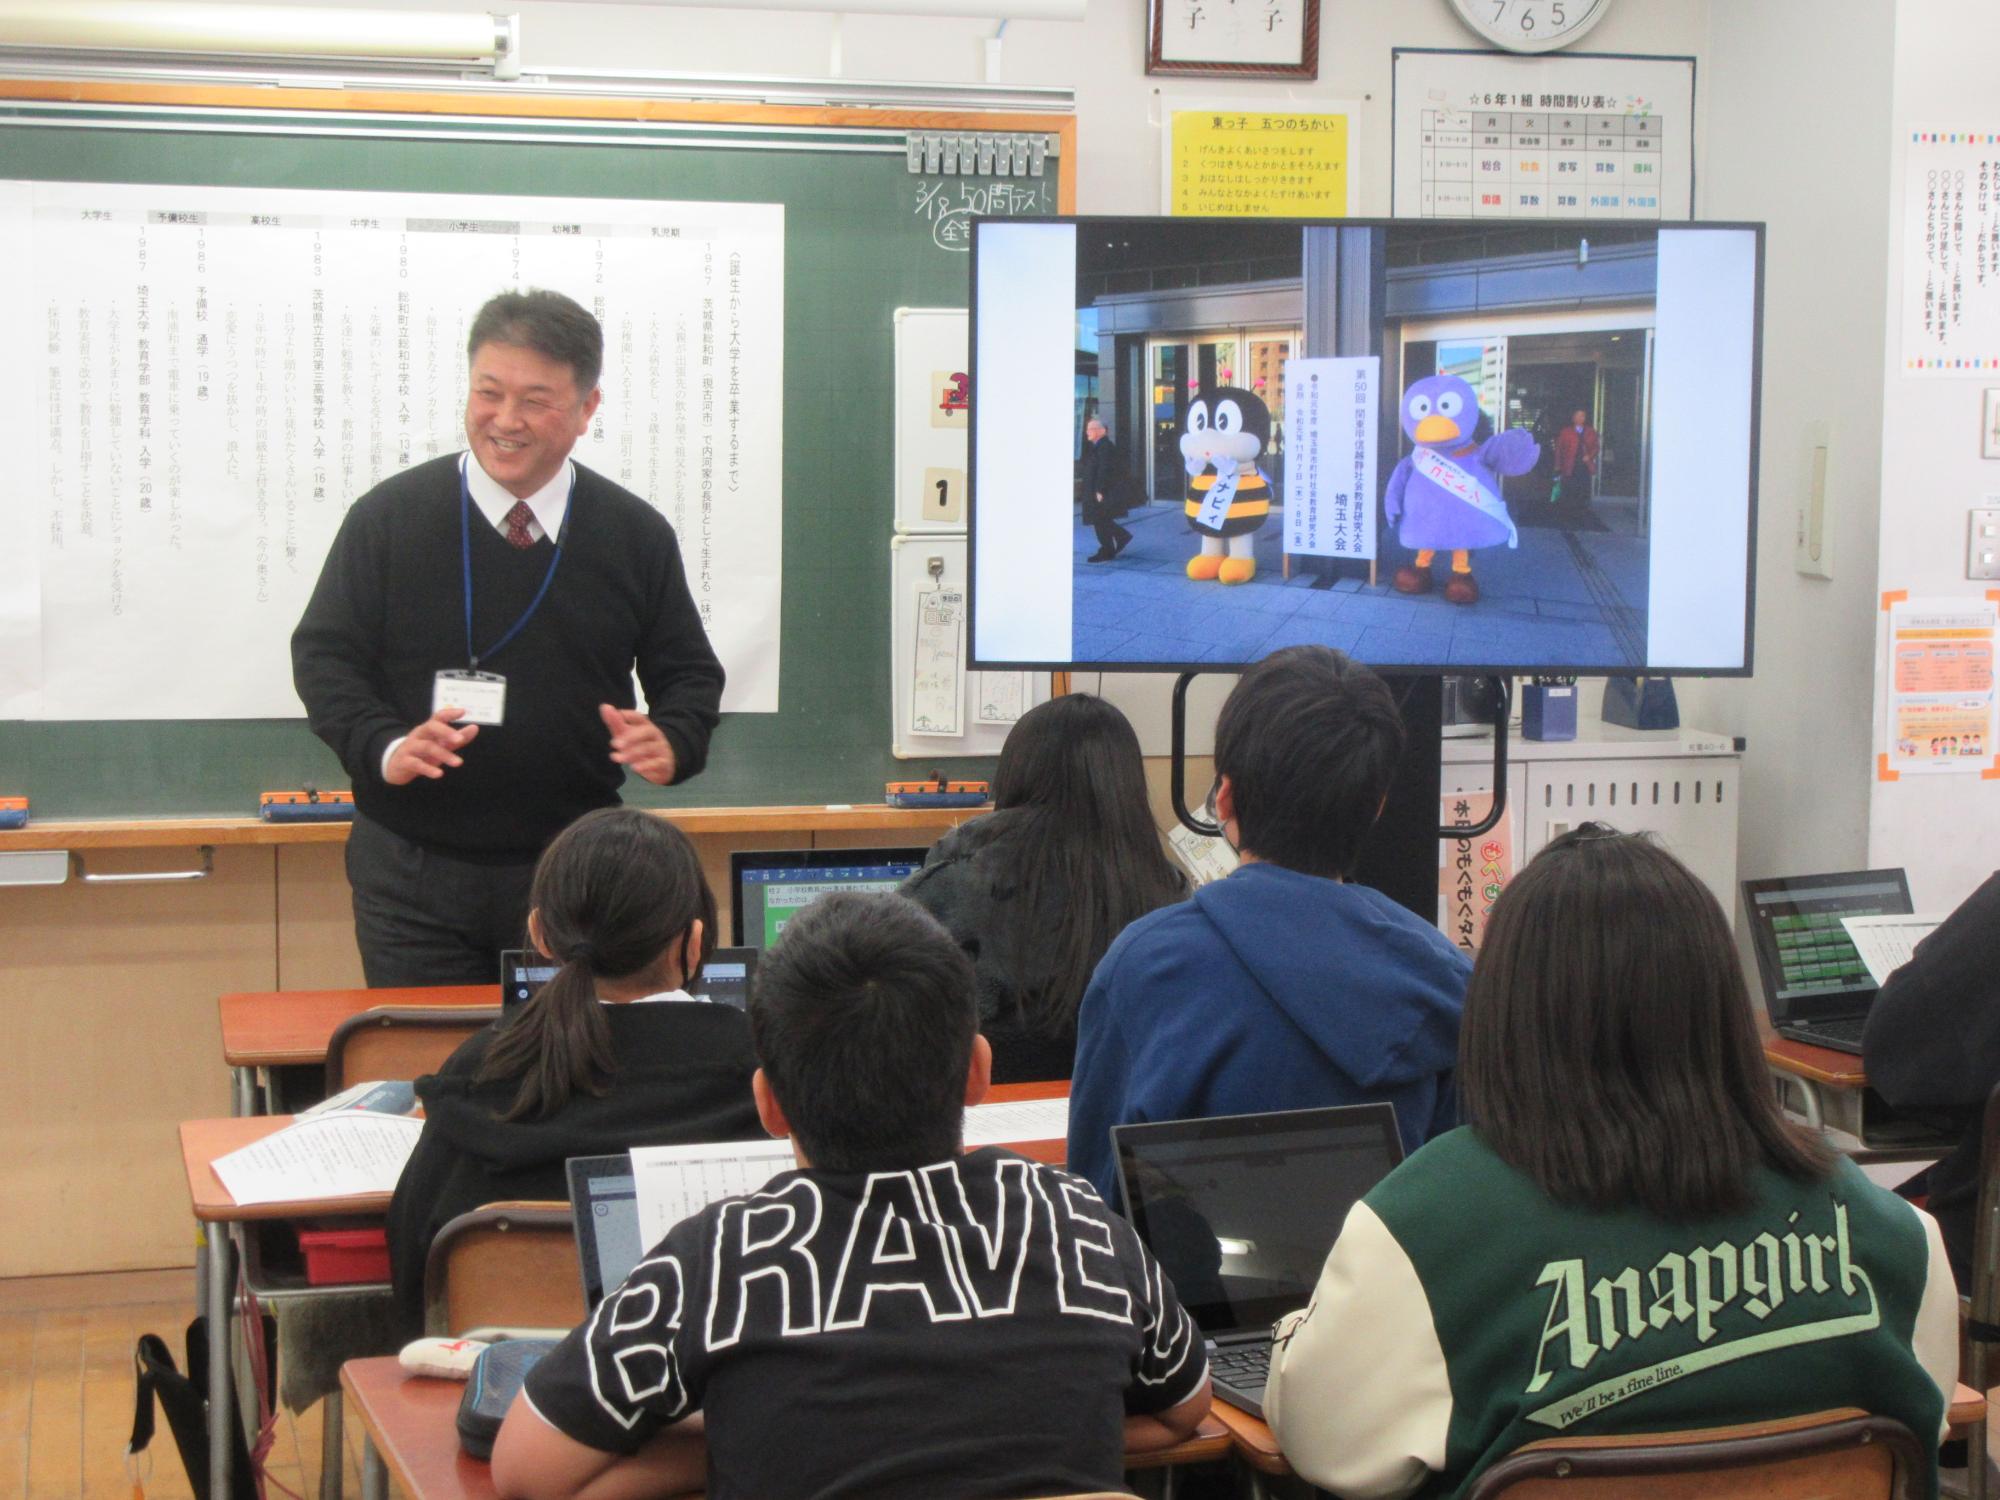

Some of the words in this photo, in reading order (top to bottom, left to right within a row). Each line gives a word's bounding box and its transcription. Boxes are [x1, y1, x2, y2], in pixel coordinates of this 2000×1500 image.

[1493, 1, 1506, 24] 7
[1520, 8, 1535, 31] 6
[1551, 3, 1565, 26] 5
[1212, 116, 1248, 130] 東っ子
[1261, 117, 1335, 131] 五つのちかい
[1525, 119, 1534, 128] 火
[1563, 120, 1572, 128] 水
[1481, 160, 1501, 172] 総合
[1595, 162, 1615, 173] 算数
[1633, 163, 1653, 174] 理科
[1481, 194, 1501, 206] 国語
[1519, 195, 1540, 206] 算数
[1557, 195, 1577, 206] 算数
[1590, 196, 1619, 207] 外国語
[82, 210, 113, 221] 大学生
[158, 212, 199, 224] 予備校生
[250, 215, 281, 226] 高校生
[350, 218, 381, 230] 中学生
[449, 221, 479, 232] 小学生
[552, 224, 582, 235] 幼稚園
[138, 226, 147, 271] 1987
[313, 231, 322, 277] 1983
[399, 233, 408, 279] 1980
[512, 237, 520, 280] 1974
[137, 285, 150, 332] 埼玉大学
[196, 286, 208, 322] 予備校
[138, 338, 151, 386] 教育学部
[1354, 369, 1368, 404] 第50回
[139, 392, 151, 439] 教育学科
[1353, 408, 1366, 553] 関東甲信越静社会教育研究大会
[1334, 492, 1348, 552] 埼玉大会
[1525, 1196, 1858, 1393] Anapgirl
[1598, 1391, 1616, 1407] be
[1617, 1387, 1626, 1399] a
[1626, 1373, 1653, 1395] fine
[1655, 1363, 1684, 1384] line.
